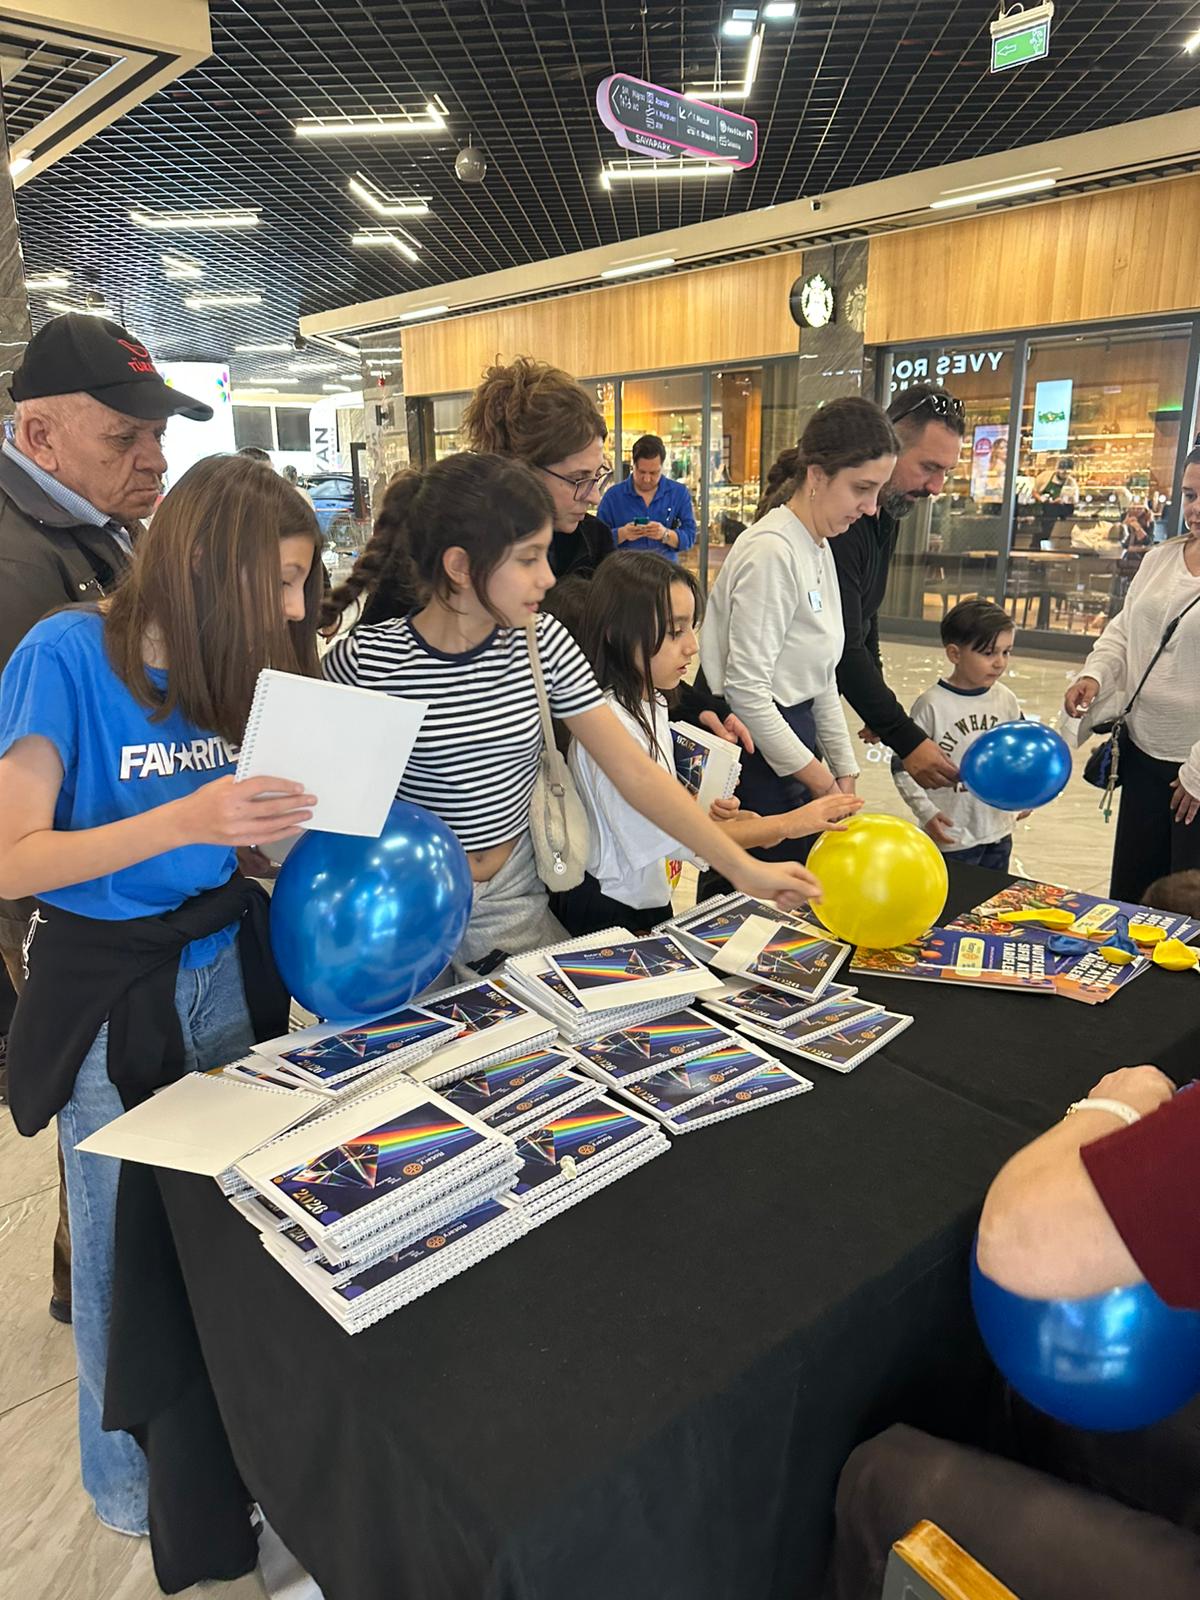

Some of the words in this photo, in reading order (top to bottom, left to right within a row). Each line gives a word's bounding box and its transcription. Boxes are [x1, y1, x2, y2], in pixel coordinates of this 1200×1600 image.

[954, 714, 998, 736] WHAT
[1017, 943, 1030, 961] SIFIR
[1032, 944, 1045, 980] MUTFAKTA
[631, 1086, 661, 1105] 2026
[420, 1151, 445, 1166] Rotary
[292, 1188, 329, 1215] 2026
[443, 1223, 467, 1238] Rotary
